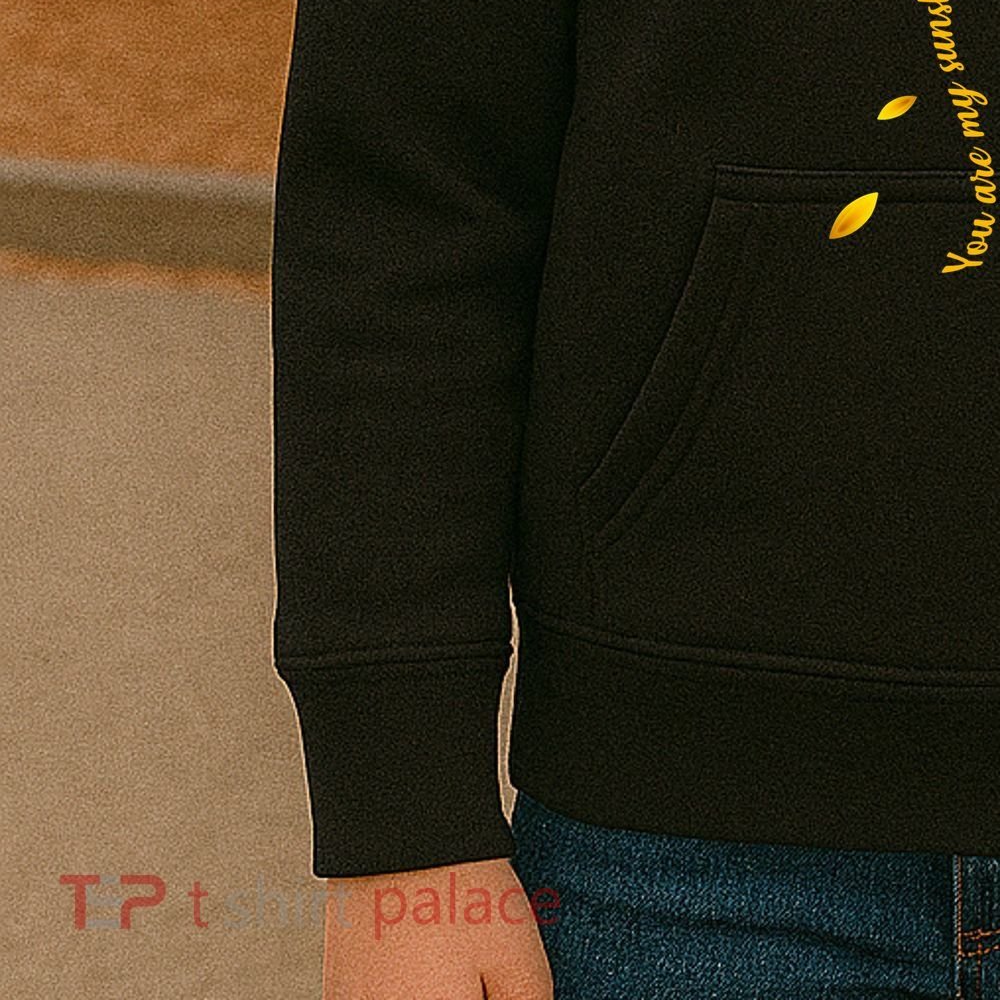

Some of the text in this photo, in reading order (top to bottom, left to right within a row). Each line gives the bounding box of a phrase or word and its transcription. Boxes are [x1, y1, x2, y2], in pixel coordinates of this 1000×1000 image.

[947, 81, 989, 138] my
[968, 146, 997, 204] are
[941, 211, 996, 274] You
